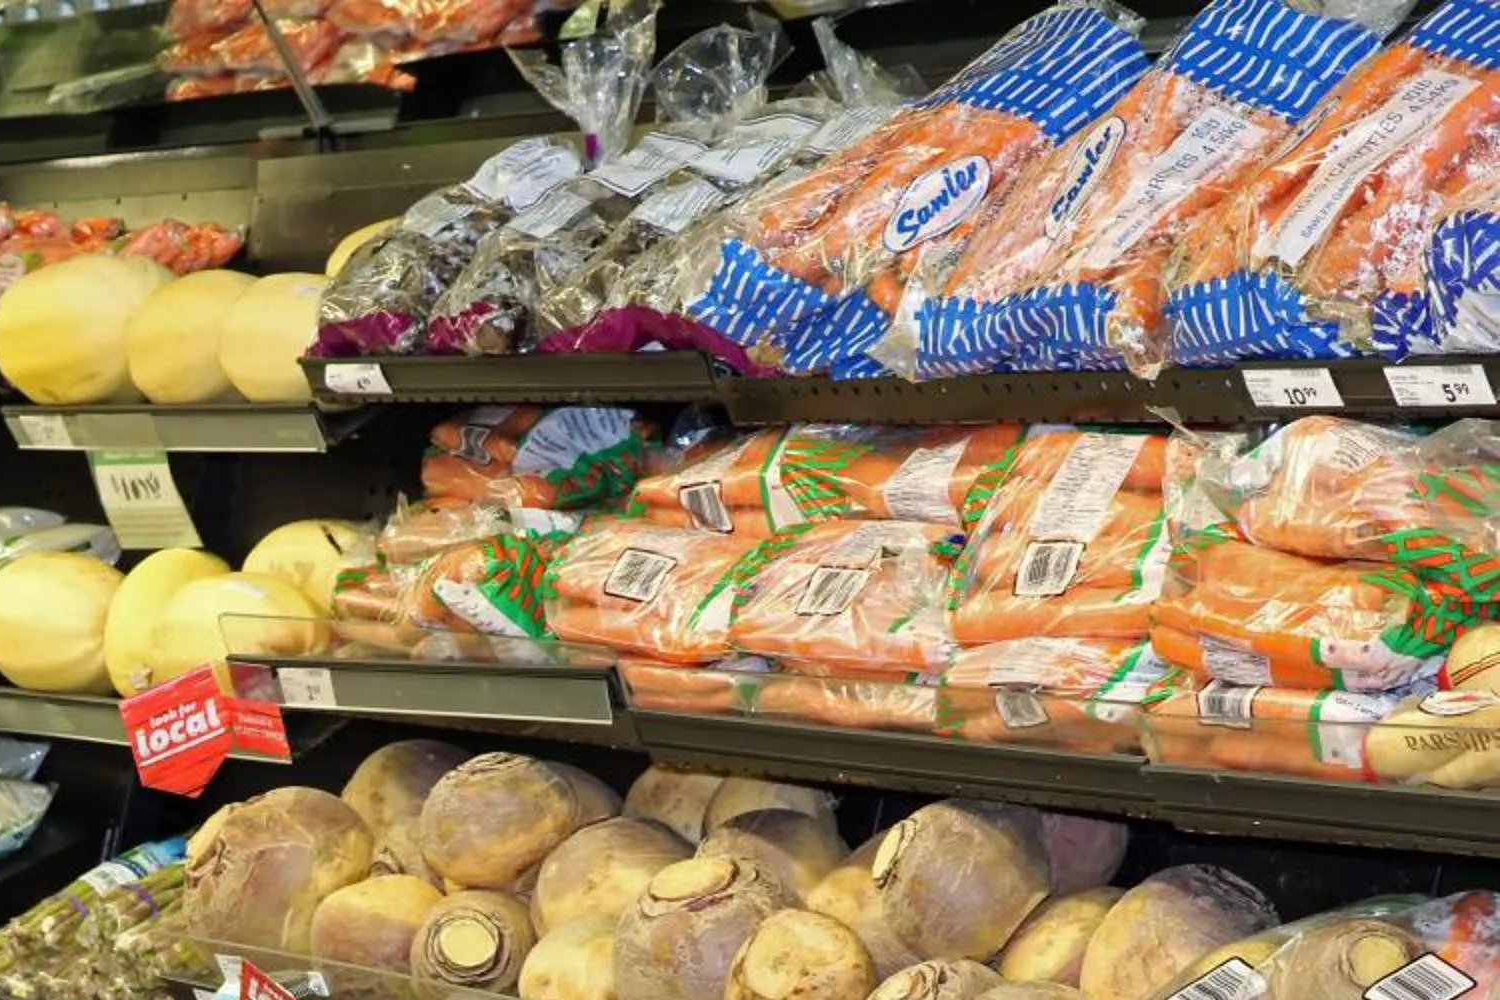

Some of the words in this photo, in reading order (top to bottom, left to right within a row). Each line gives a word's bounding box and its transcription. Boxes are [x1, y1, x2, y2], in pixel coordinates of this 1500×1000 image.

[896, 161, 979, 247] Sawler
[1051, 127, 1112, 222] Sawler
[135, 698, 221, 758] local
